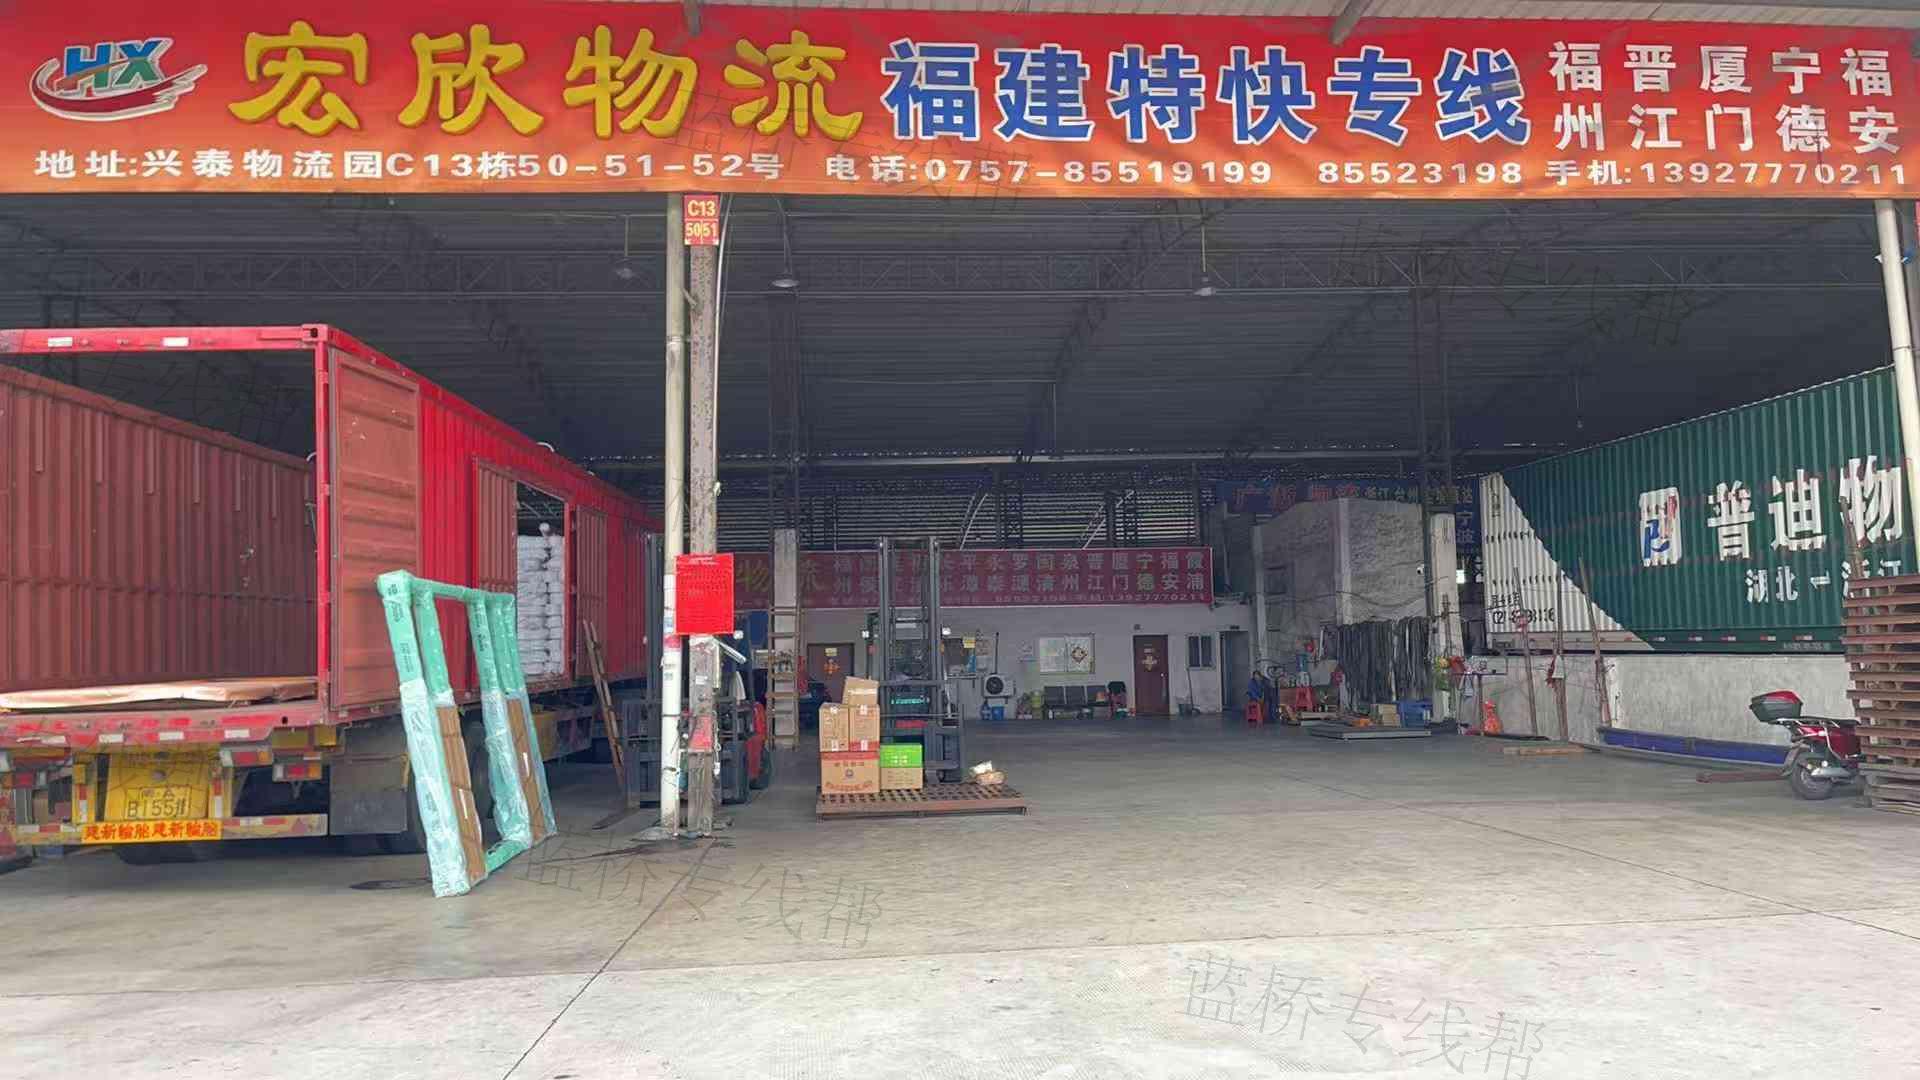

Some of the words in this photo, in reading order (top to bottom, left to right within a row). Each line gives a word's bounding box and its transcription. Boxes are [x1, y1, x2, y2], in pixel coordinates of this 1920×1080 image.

[54, 37, 172, 97] HX
[228, 20, 864, 138] 宏欣物流
[880, 38, 1530, 146] 福建特快专线
[688, 200, 716, 217] C13
[1318, 161, 1523, 185] 85523198
[1545, 159, 1906, 187] 手机:13927770211
[1707, 455, 1902, 561] 普迪物
